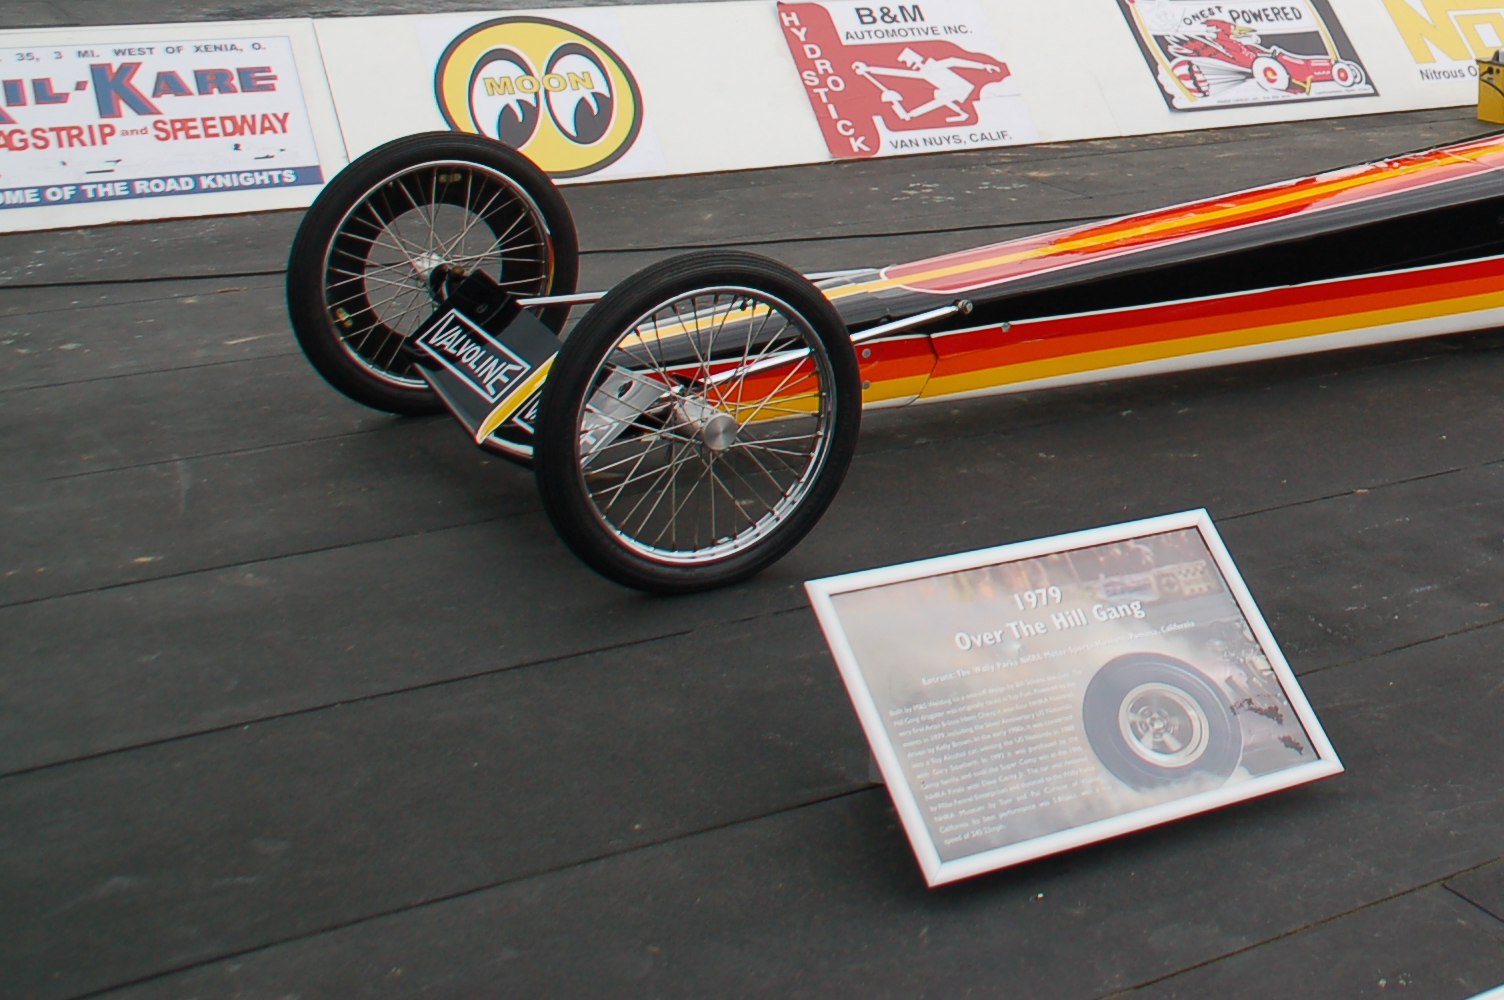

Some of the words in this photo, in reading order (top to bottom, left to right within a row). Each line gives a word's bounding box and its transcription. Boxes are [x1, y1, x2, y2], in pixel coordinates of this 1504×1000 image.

[854, 4, 925, 25] B&M
[1228, 6, 1303, 25] POWERED
[845, 26, 940, 41] AUTOMOTIVE
[944, 24, 973, 35] INC.
[16, 51, 40, 62] 35,
[53, 51, 63, 60] 3
[77, 49, 100, 59] MI.
[113, 47, 155, 57] WEST
[165, 46, 184, 55] OF
[194, 43, 243, 53] XENIA,
[483, 71, 595, 96] MOON
[1420, 67, 1464, 81] Nitrous
[802, 71, 870, 152] STICK
[120, 125, 149, 137] and
[153, 112, 290, 142] SPEEDWAY
[890, 138, 920, 150] VAN
[923, 134, 967, 147] NUYS,
[969, 130, 1013, 143] CALIF.
[45, 186, 77, 201] OF
[81, 181, 129, 199] THE
[135, 176, 195, 195] ROAD
[200, 169, 297, 191] KNIGHTS
[429, 314, 524, 396] VALVOLINE
[1013, 585, 1063, 612] 1979
[953, 626, 1004, 653] Over
[1006, 617, 1049, 643] The
[1051, 607, 1088, 634] Hill
[1092, 598, 1147, 625] Gang
